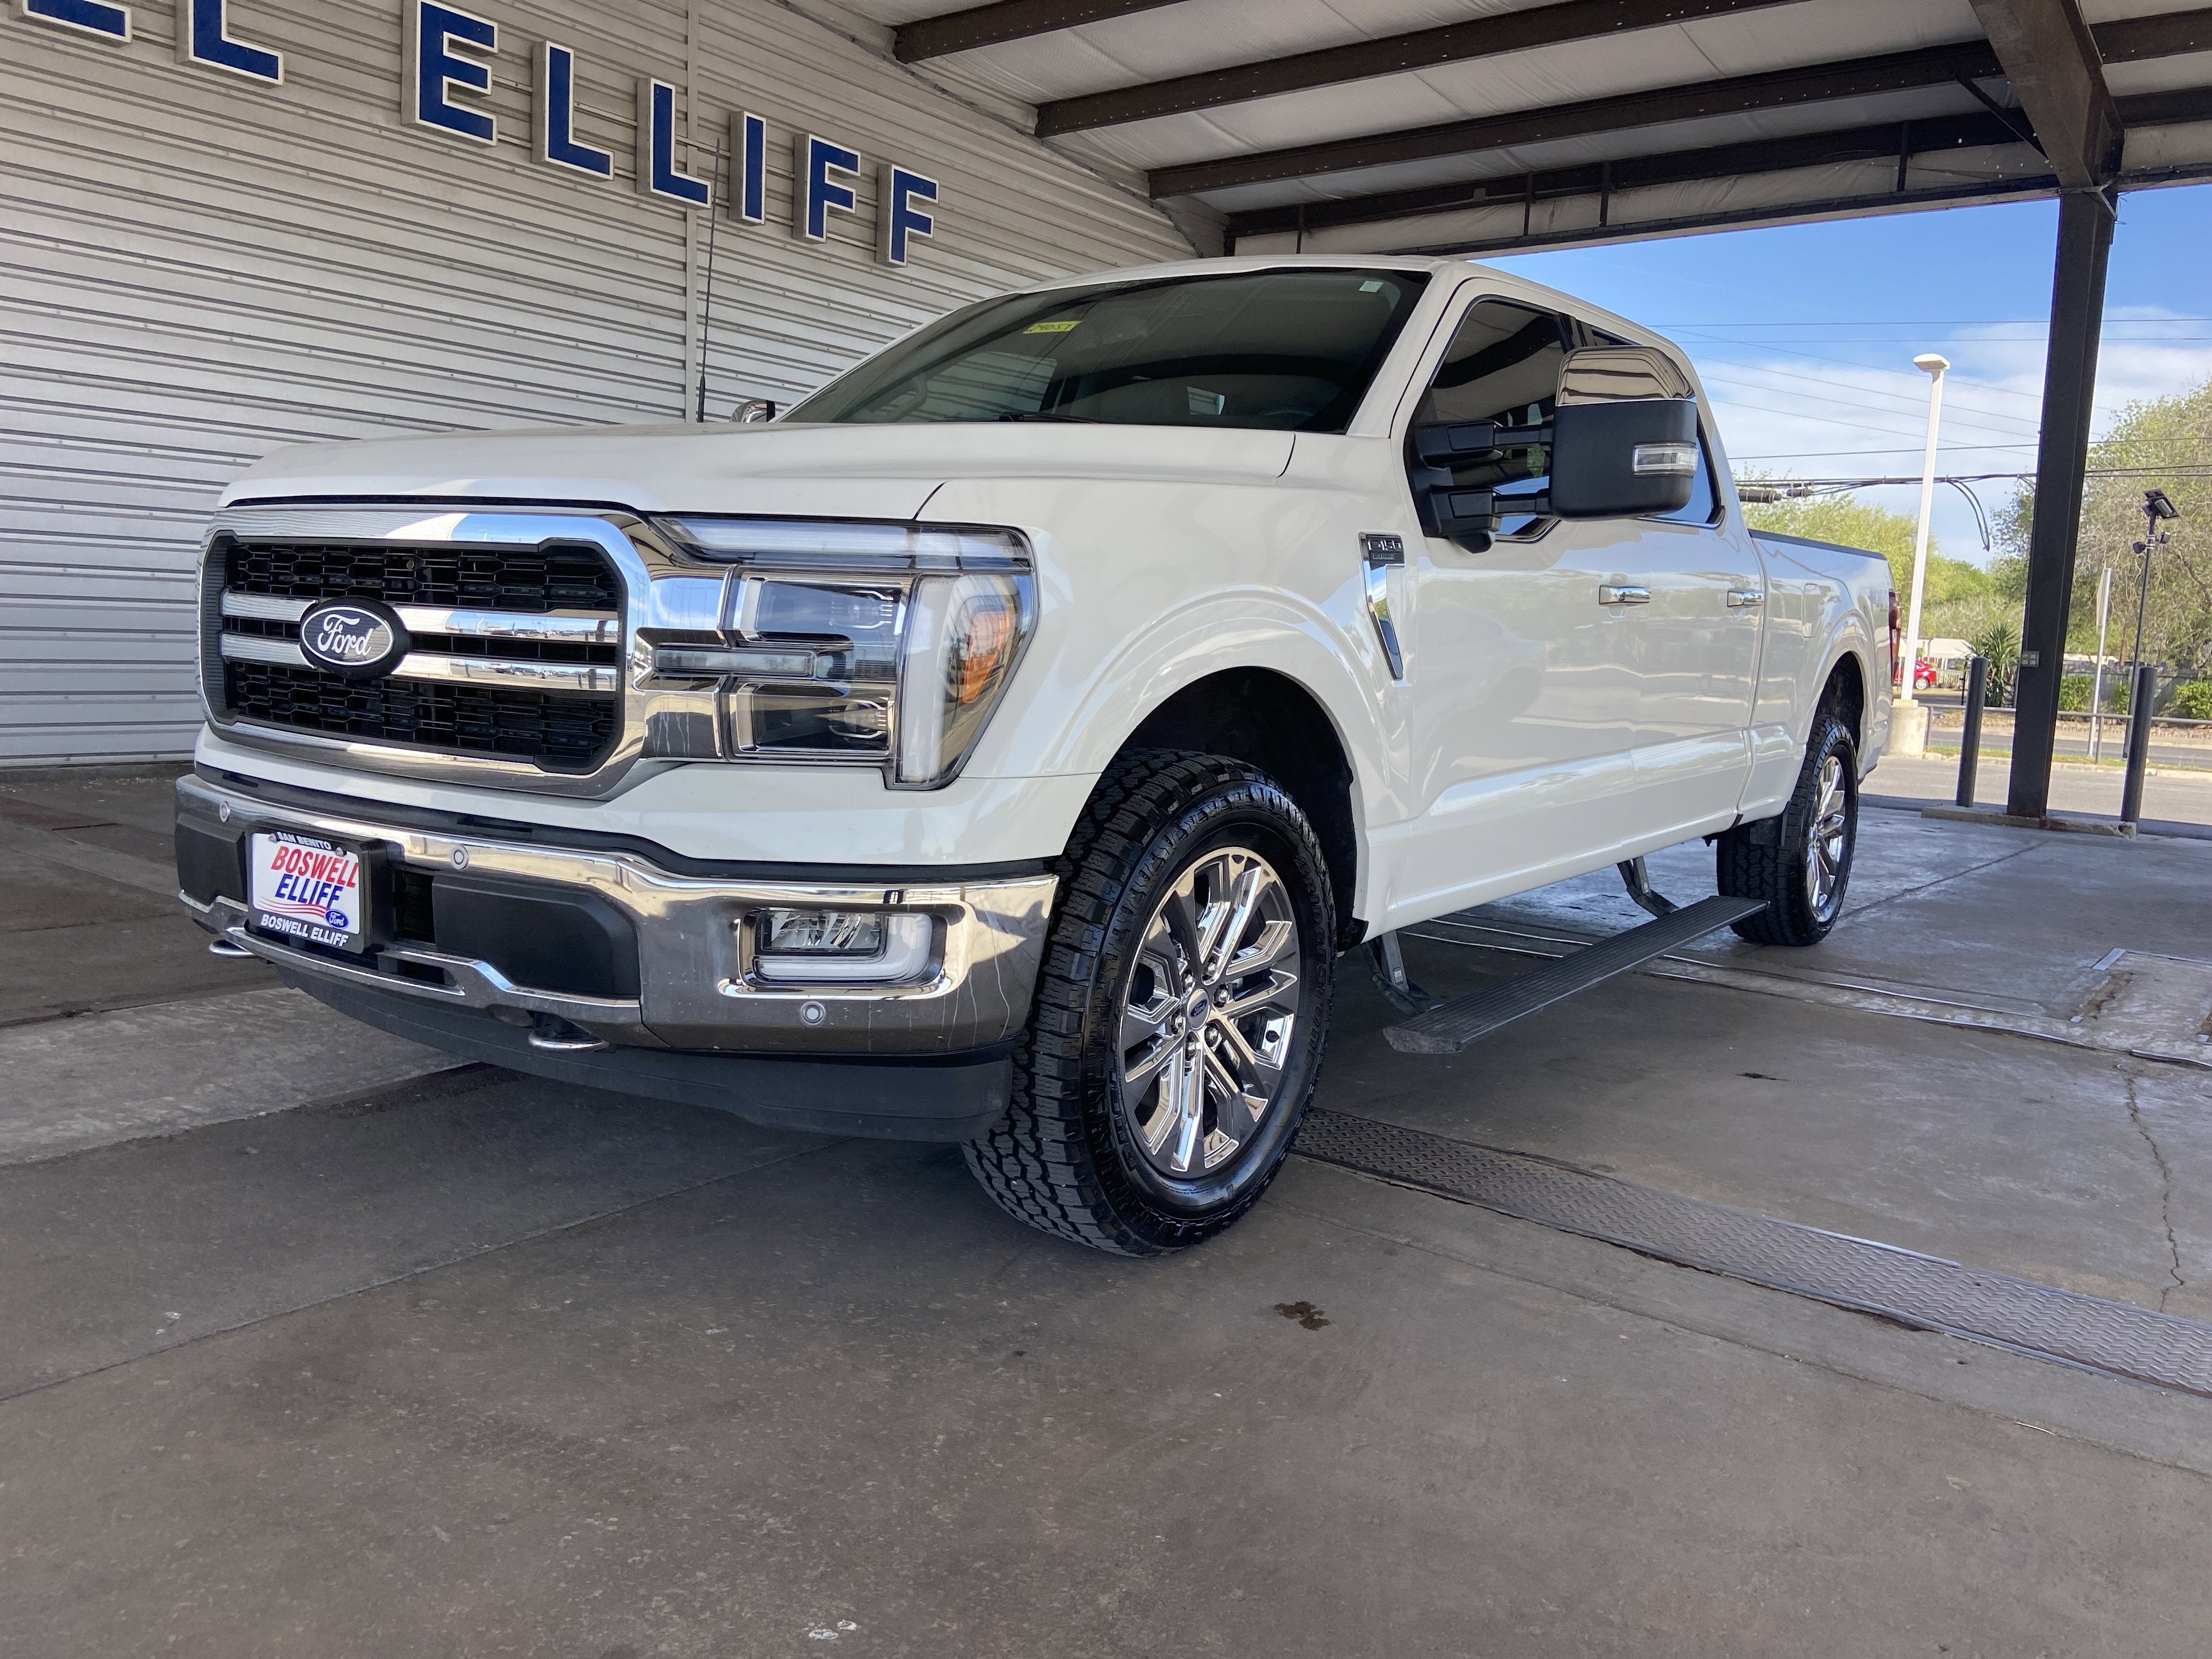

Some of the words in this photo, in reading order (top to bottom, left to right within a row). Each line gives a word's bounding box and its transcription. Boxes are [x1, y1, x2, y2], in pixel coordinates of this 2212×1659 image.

[414, 0, 940, 268] ELLIFF
[317, 613, 374, 656] Ford
[276, 831, 297, 844] SAN
[298, 836, 332, 850] BENITO
[270, 846, 359, 888] BOSWELL
[275, 873, 344, 909] ELLIFF
[260, 913, 308, 938] BOSWELL
[310, 927, 349, 947] ELLIFF
[329, 911, 345, 927] Ford
